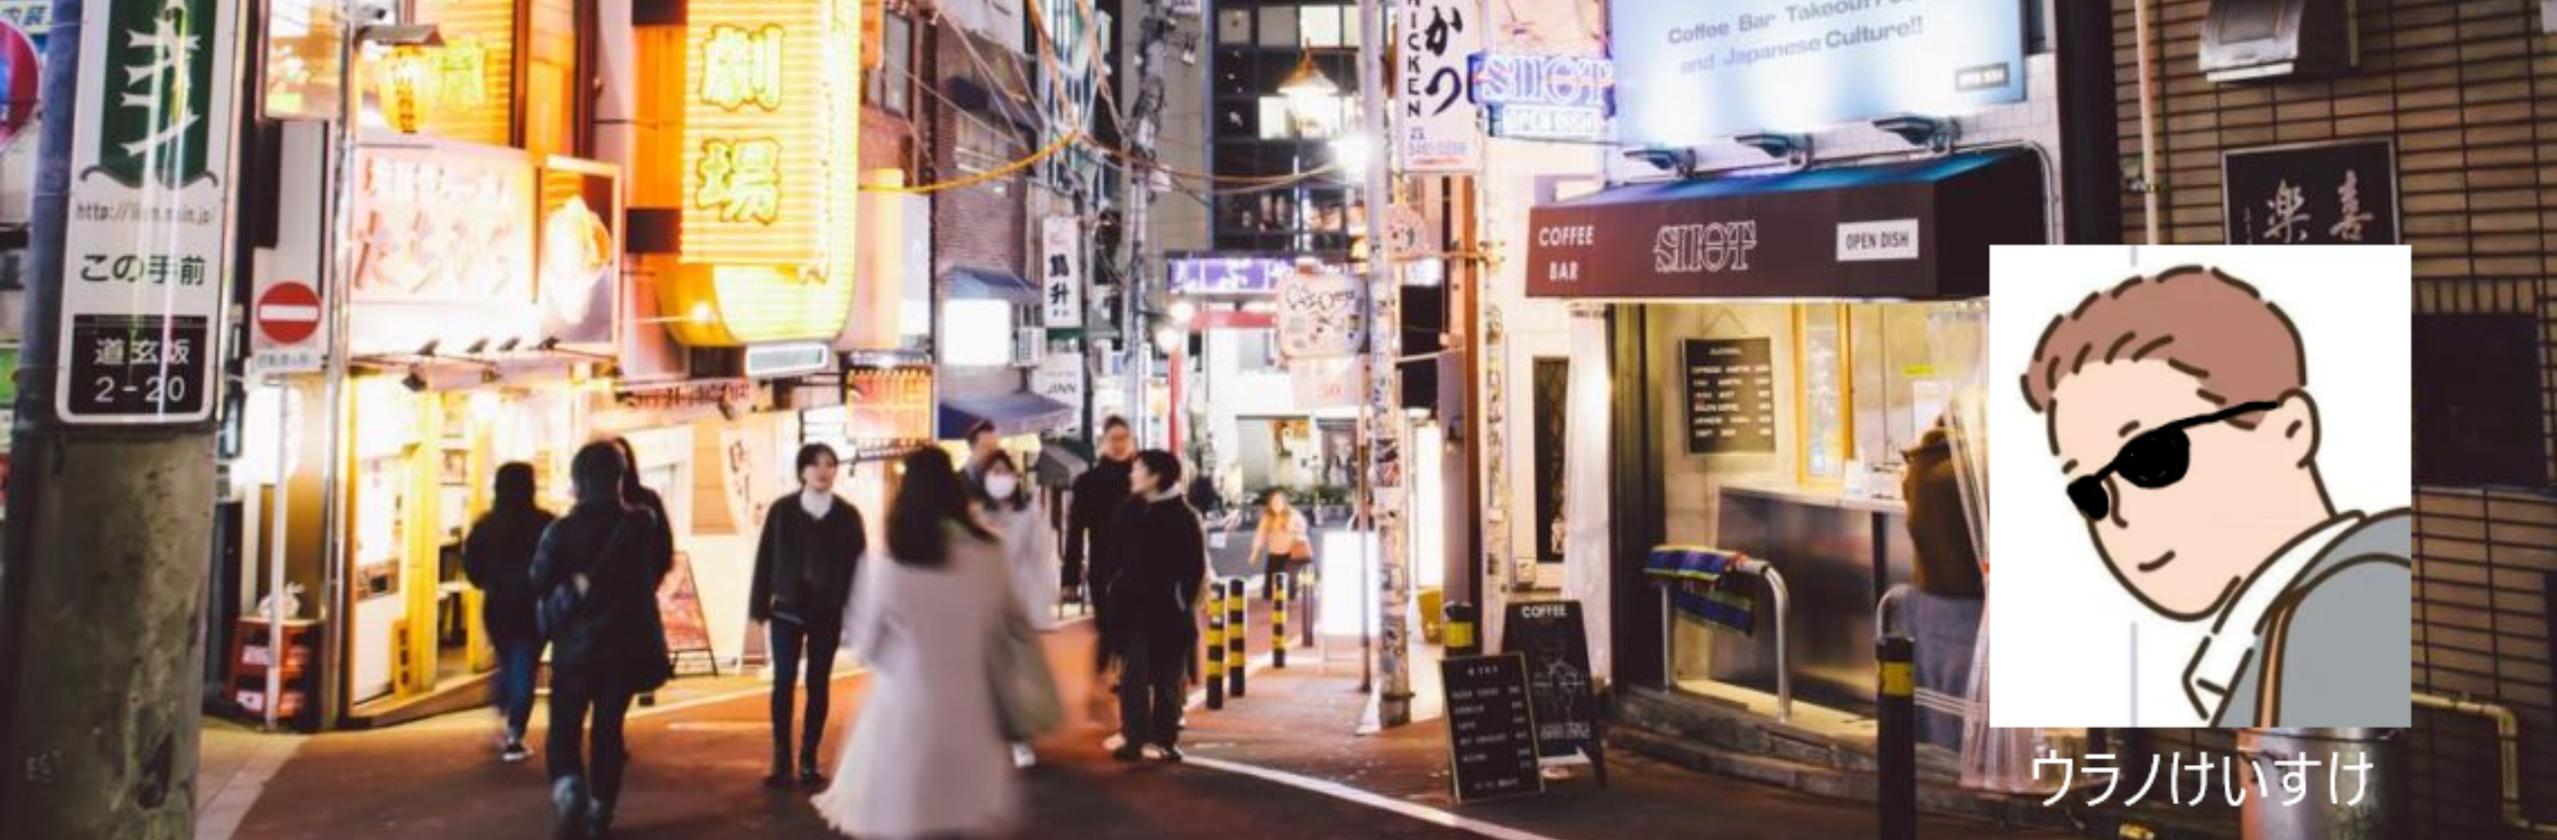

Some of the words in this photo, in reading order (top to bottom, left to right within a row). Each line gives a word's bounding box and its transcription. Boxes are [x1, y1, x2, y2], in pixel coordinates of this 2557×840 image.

[1668, 22, 1730, 44] Coffee
[1738, 14, 1775, 32] Bar
[1681, 52, 1714, 74] and
[1722, 38, 1822, 66] Japanese
[697, 23, 785, 224] 劇場
[1538, 226, 1595, 247] COFFEE
[1845, 232, 1877, 250] OPEN
[1880, 230, 1909, 248] DISH
[80, 254, 206, 286] この手前
[1549, 260, 1577, 282] BAR
[94, 337, 191, 365] 道玄坂
[94, 375, 186, 403] 2-20
[1521, 604, 1568, 618] COFFEE
